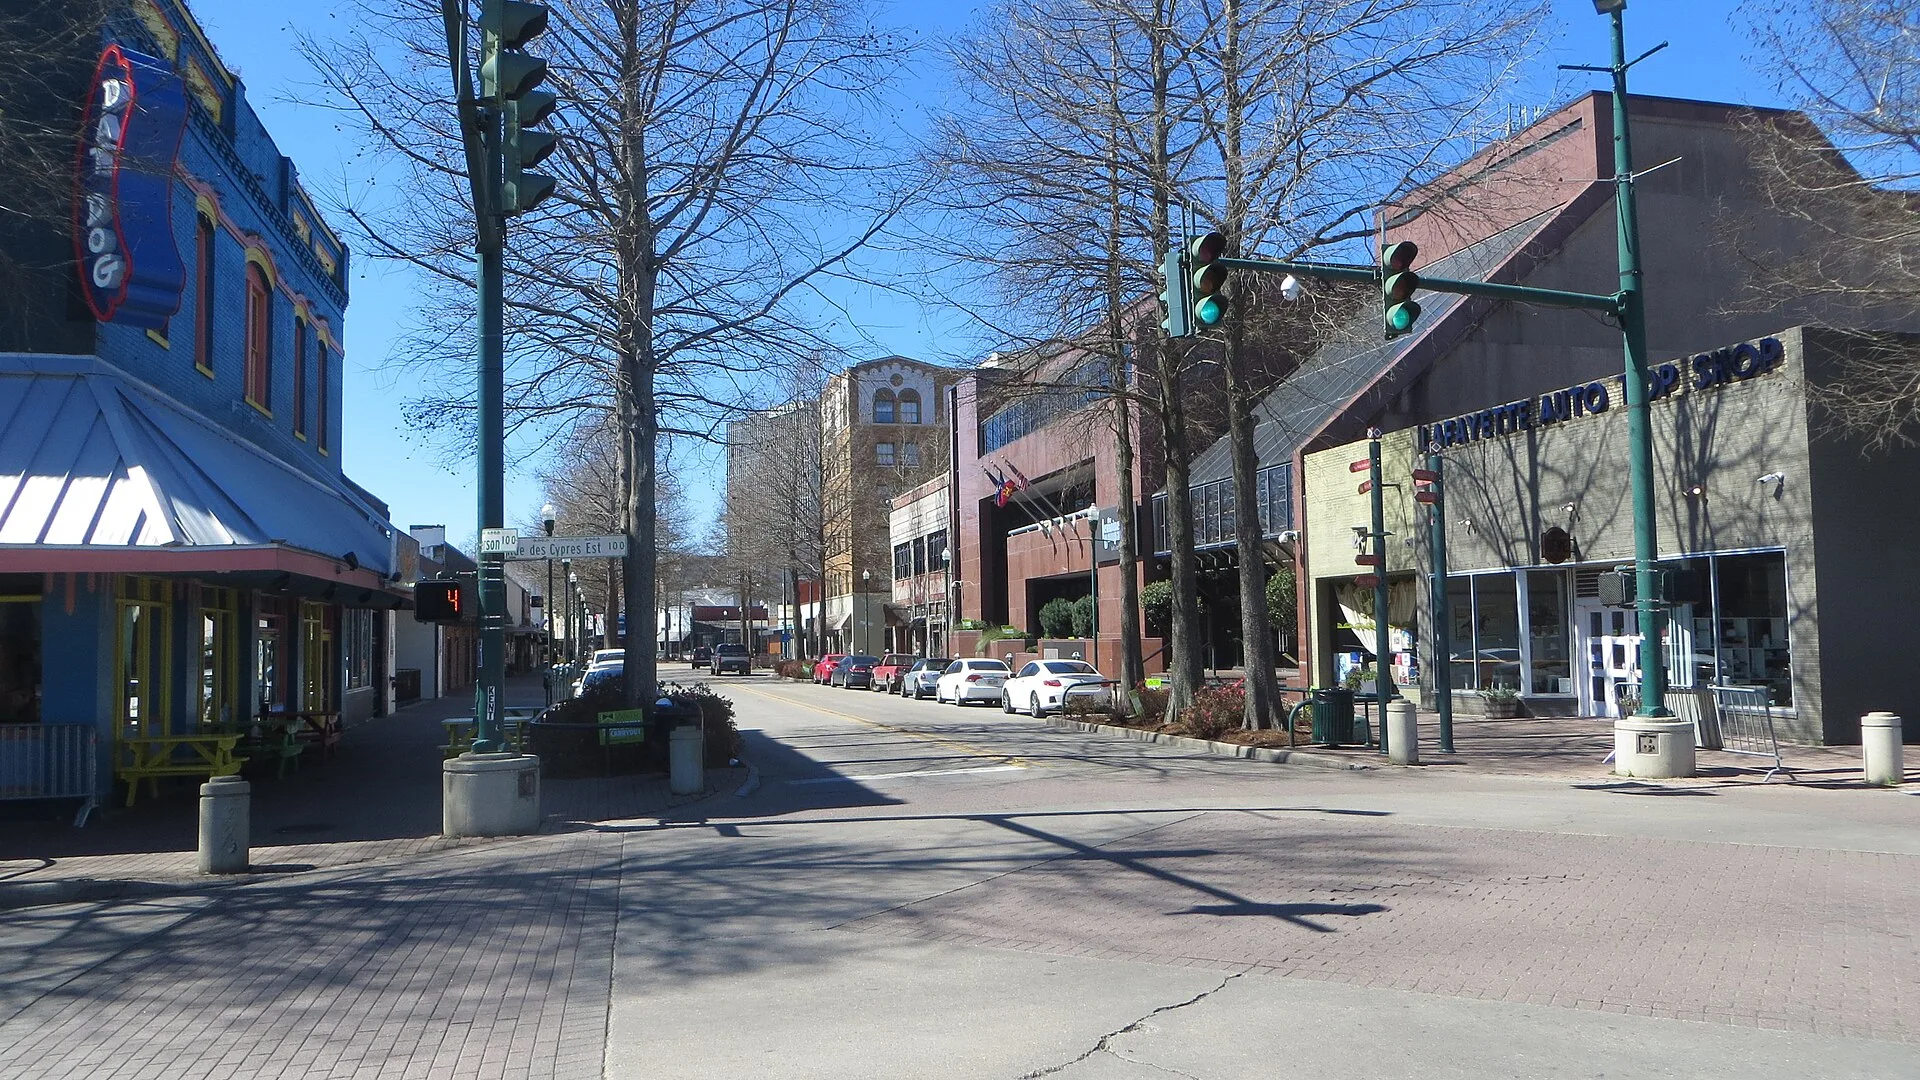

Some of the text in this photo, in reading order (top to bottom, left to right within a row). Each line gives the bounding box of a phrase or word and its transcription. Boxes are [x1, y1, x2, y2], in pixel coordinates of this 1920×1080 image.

[86, 192, 125, 290] DOG
[1417, 400, 1531, 454] LAFAYETTE
[1540, 382, 1609, 425] AUTO
[1692, 336, 1785, 390] SHOP
[484, 535, 516, 551] son 100
[529, 544, 546, 556] des
[549, 543, 582, 557] Cypres
[585, 542, 602, 554] Est
[607, 541, 625, 550] 100
[447, 589, 458, 612] 4
[487, 686, 496, 720] KENT
